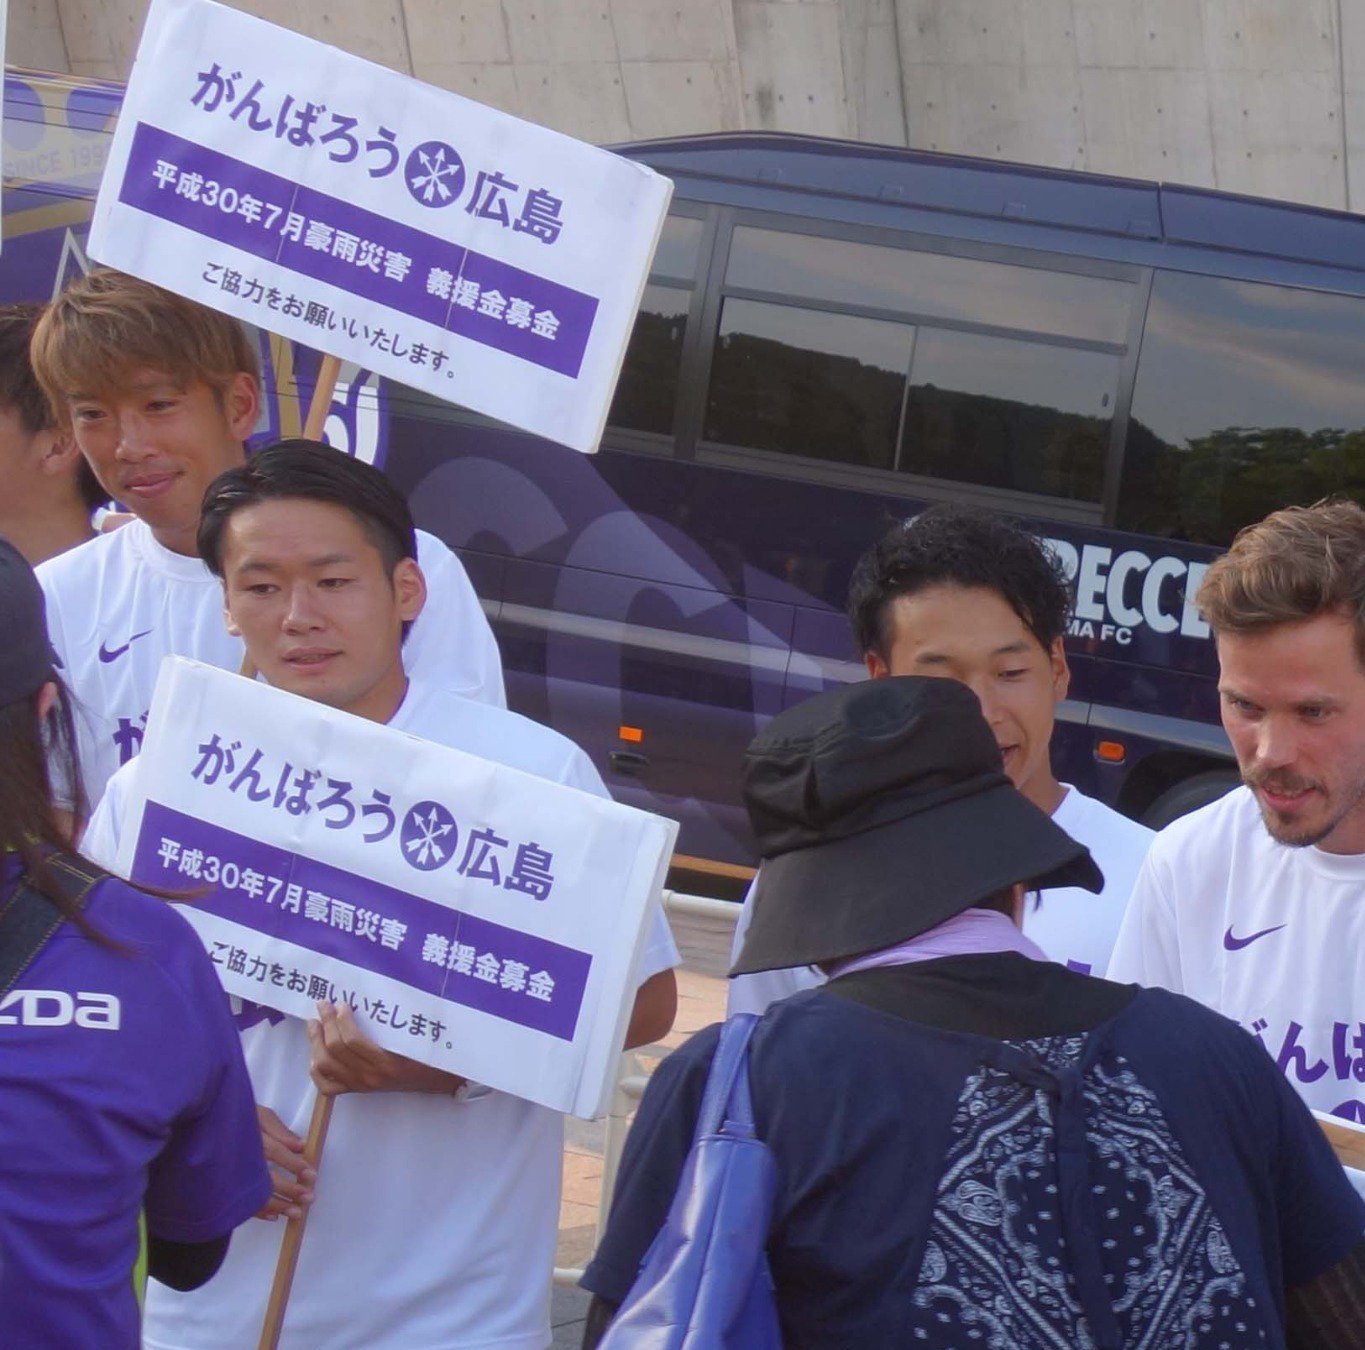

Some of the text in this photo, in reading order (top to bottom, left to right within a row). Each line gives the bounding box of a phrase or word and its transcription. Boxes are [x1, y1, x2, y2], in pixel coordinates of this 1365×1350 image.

[190, 63, 565, 244] がんばろう 広島
[152, 159, 560, 341] 平成30年7月豪雨災害 義援金募金
[201, 261, 456, 380] ご協力をお願いいたします。
[1101, 624, 1132, 645] FC
[190, 733, 397, 844] がんばろう
[457, 827, 555, 901] 広島
[157, 836, 555, 1002] 平成30年7月豪雨災害 義援金募金
[208, 940, 454, 1051] ご協力をお願いいたします。
